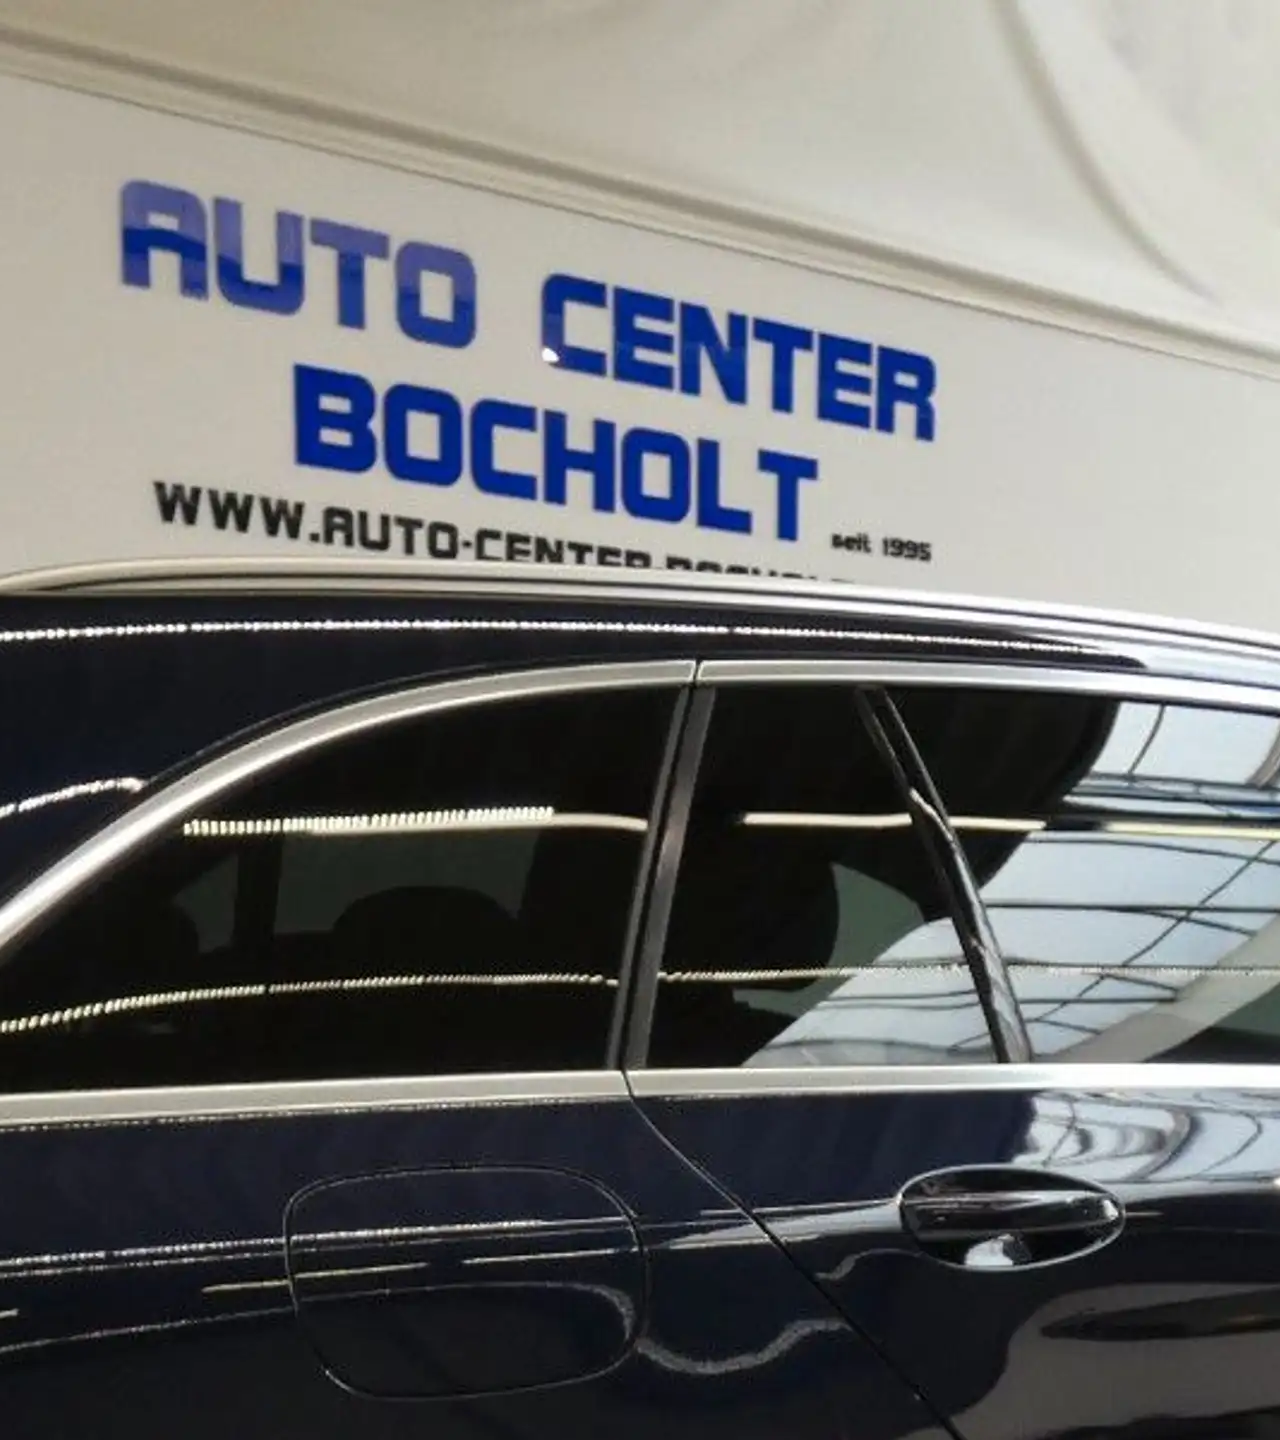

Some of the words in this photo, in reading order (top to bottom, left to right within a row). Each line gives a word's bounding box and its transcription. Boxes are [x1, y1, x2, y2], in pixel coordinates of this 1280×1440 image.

[122, 180, 478, 348] AUTO
[542, 273, 937, 441] CENTER
[294, 363, 818, 543] BOCHOLT
[882, 537, 932, 563] 1995
